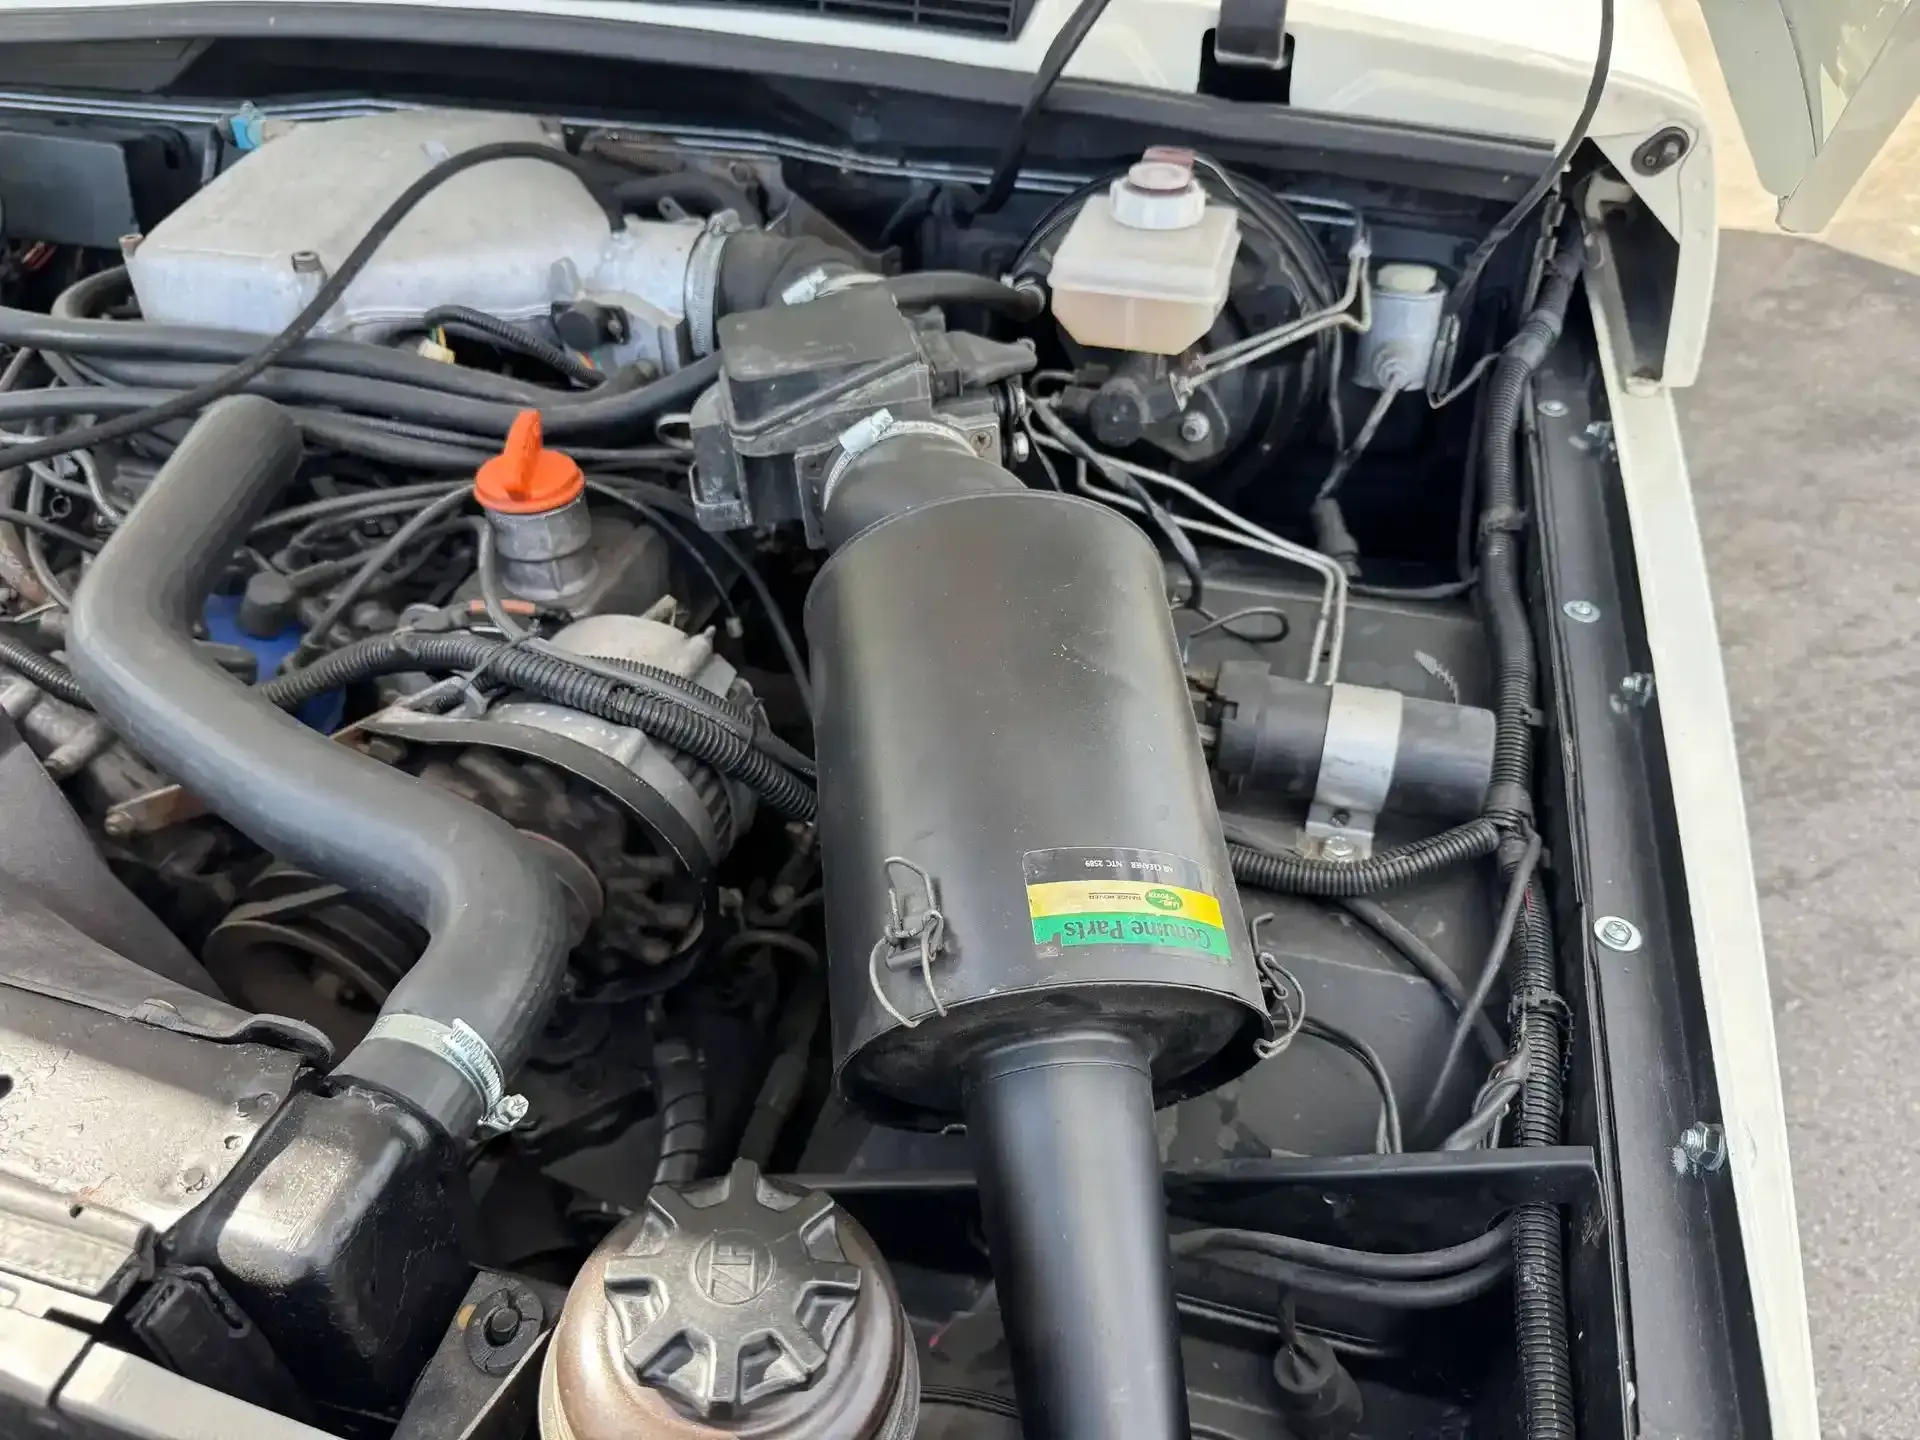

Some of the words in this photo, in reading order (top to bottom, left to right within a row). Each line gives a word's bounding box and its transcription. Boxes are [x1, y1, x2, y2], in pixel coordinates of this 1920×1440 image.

[1131, 861, 1162, 871] CLEANER
[1063, 920, 1124, 939] Parts
[1131, 920, 1212, 949] Genuine
